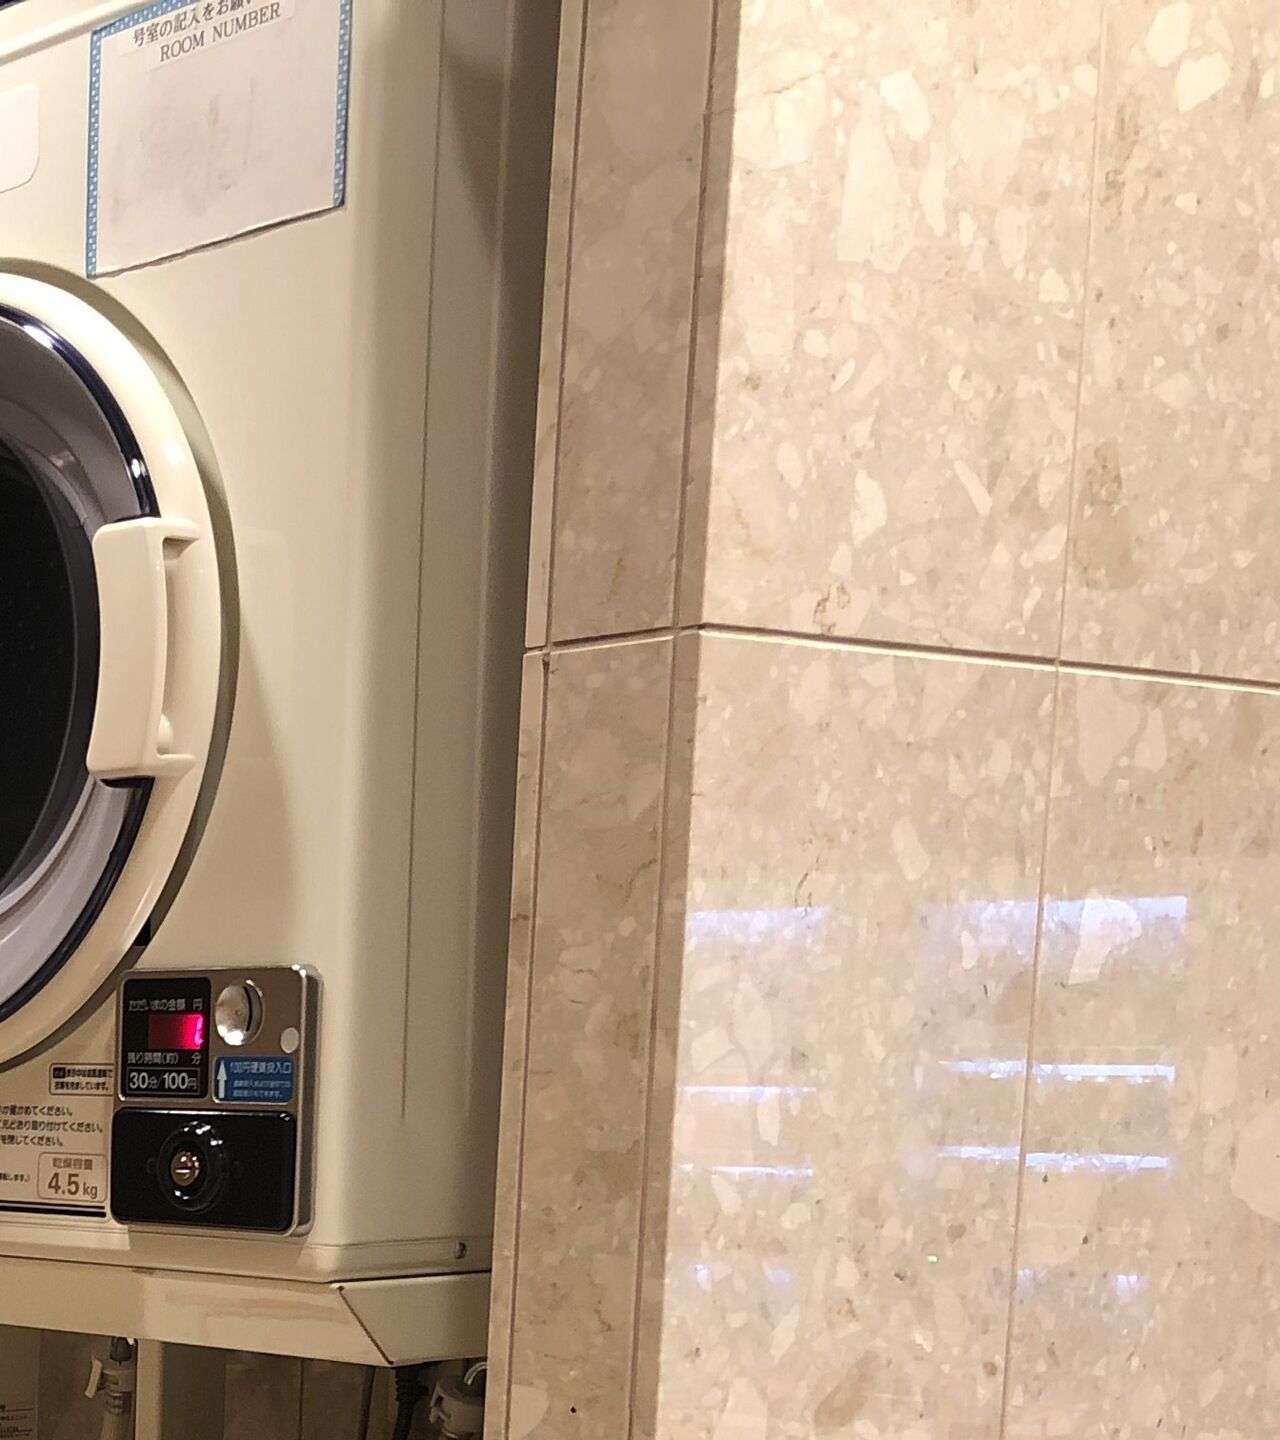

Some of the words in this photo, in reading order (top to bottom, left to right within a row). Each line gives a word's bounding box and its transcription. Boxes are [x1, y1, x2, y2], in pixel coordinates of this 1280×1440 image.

[132, 0, 251, 47] 号室の記入をお願
[159, 32, 206, 62] ROOM
[212, 1, 282, 43] NUMBER
[193, 998, 203, 1012] 円
[191, 1052, 201, 1067] 分
[52, 1157, 94, 1170] 乾燥容量
[47, 1171, 81, 1196] 4.5
[82, 1182, 99, 1201] kg
